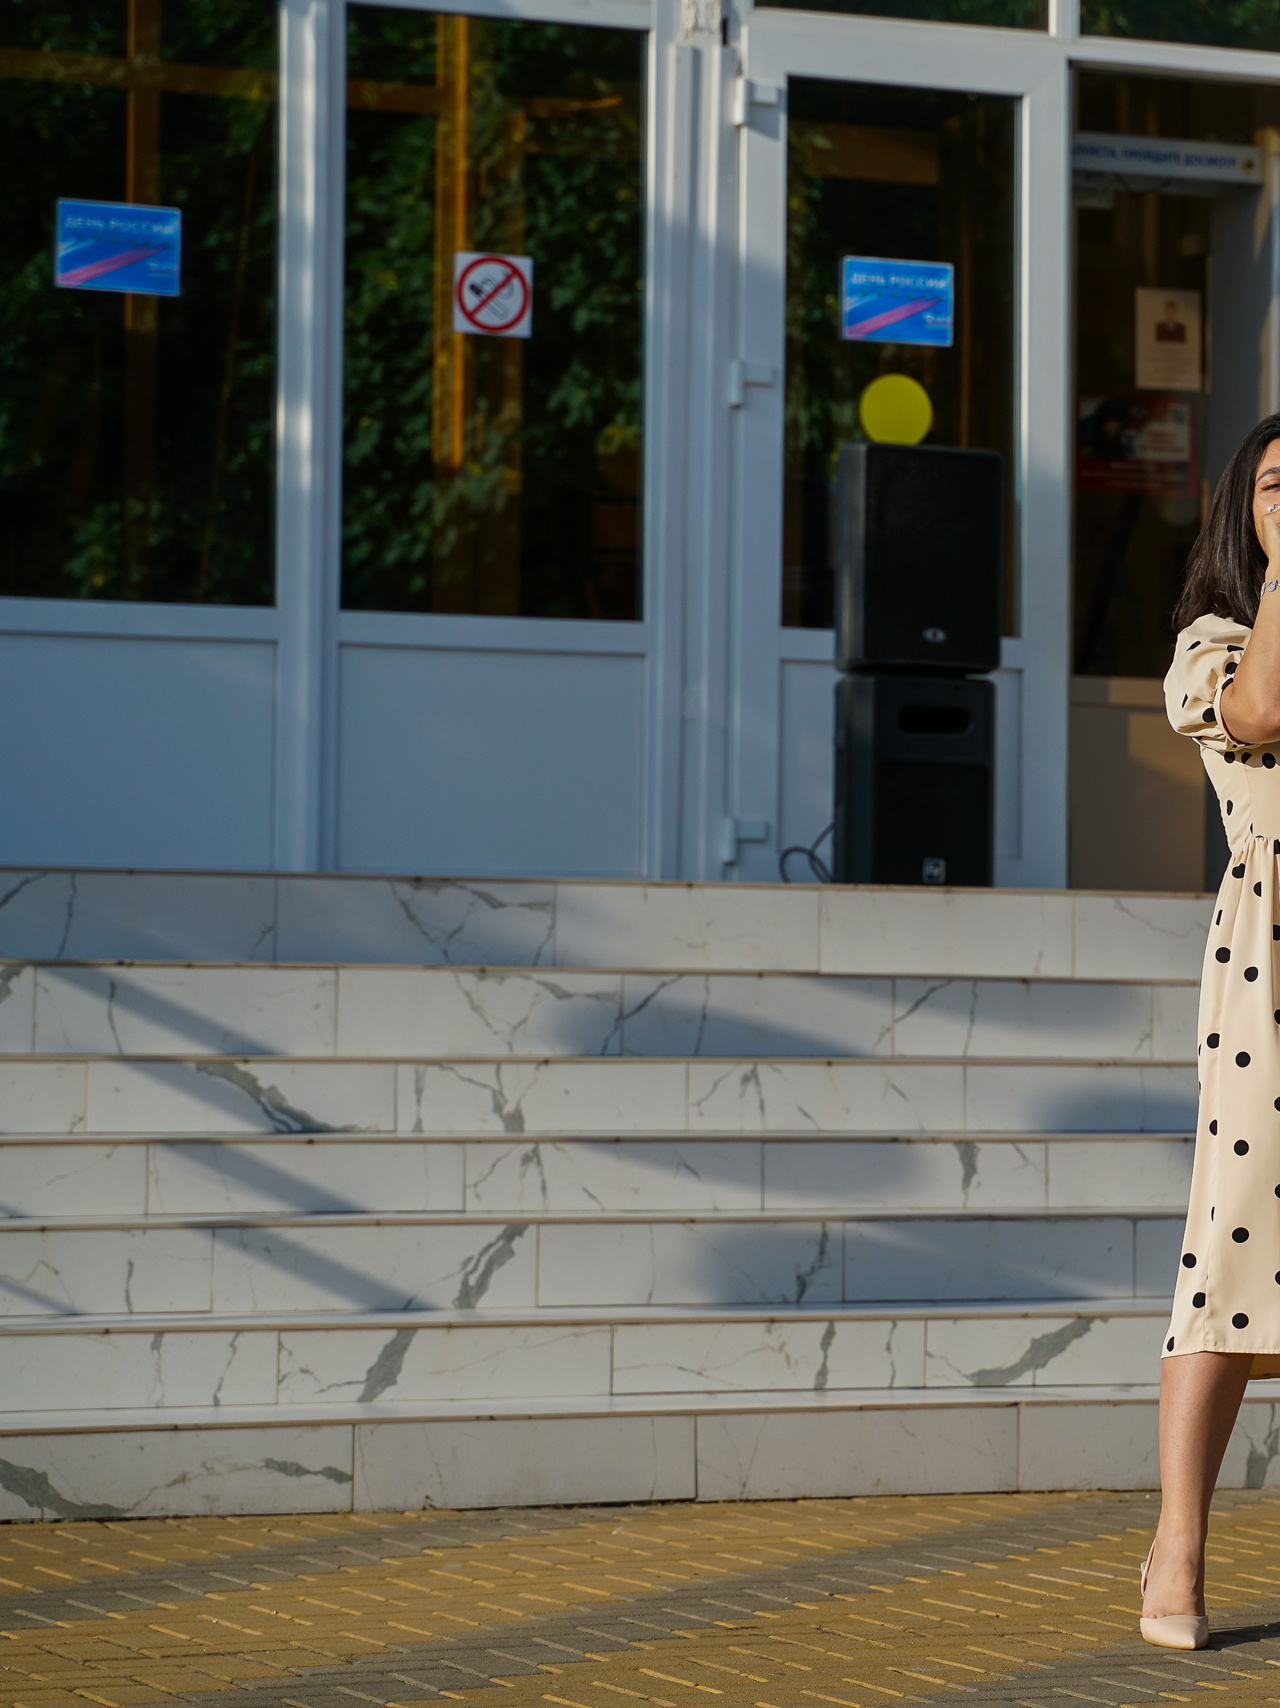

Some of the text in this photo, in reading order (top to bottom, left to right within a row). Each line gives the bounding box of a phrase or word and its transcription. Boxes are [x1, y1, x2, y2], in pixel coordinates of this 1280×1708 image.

[65, 214, 174, 234] ДЕНЬ РОССИИ
[851, 272, 885, 285] ДЕНЬ
